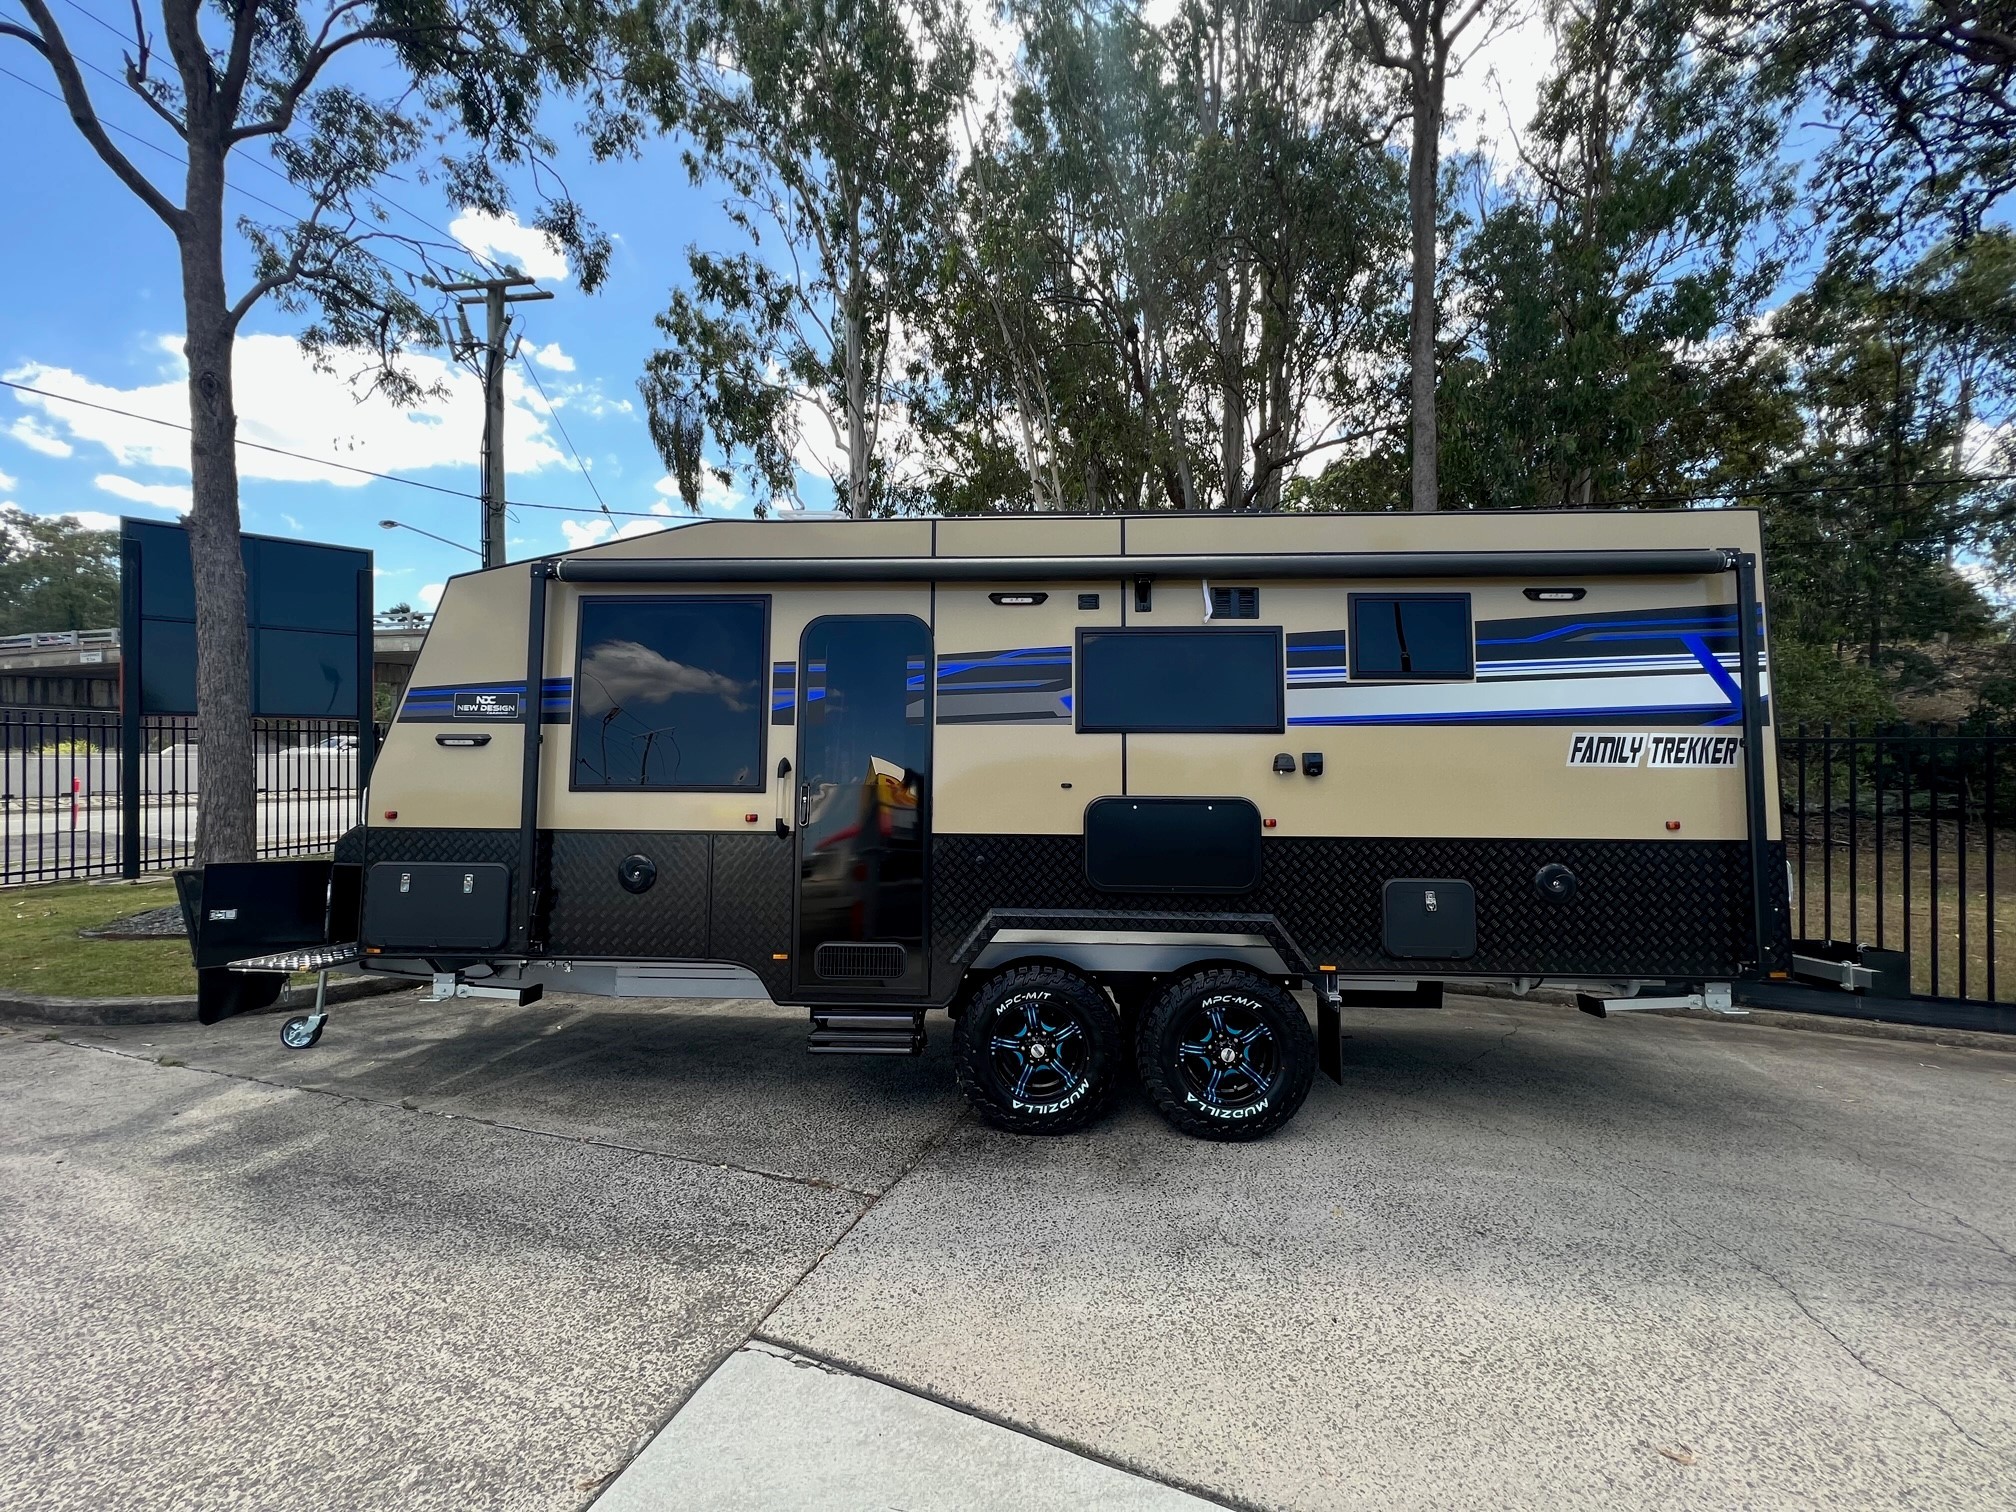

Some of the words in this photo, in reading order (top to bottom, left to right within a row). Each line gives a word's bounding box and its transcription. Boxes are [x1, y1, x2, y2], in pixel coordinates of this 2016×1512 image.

[476, 695, 497, 704] NDC
[480, 704, 515, 712] DESIGN
[1570, 736, 1644, 764] FAMILY
[1651, 736, 1738, 765] TREKKER
[996, 991, 1052, 1016] MPC-M/T
[1201, 995, 1263, 1010] MPC-M/T
[1012, 1078, 1090, 1114] MUDZILLA
[1186, 1091, 1269, 1119] MUDZILLA
